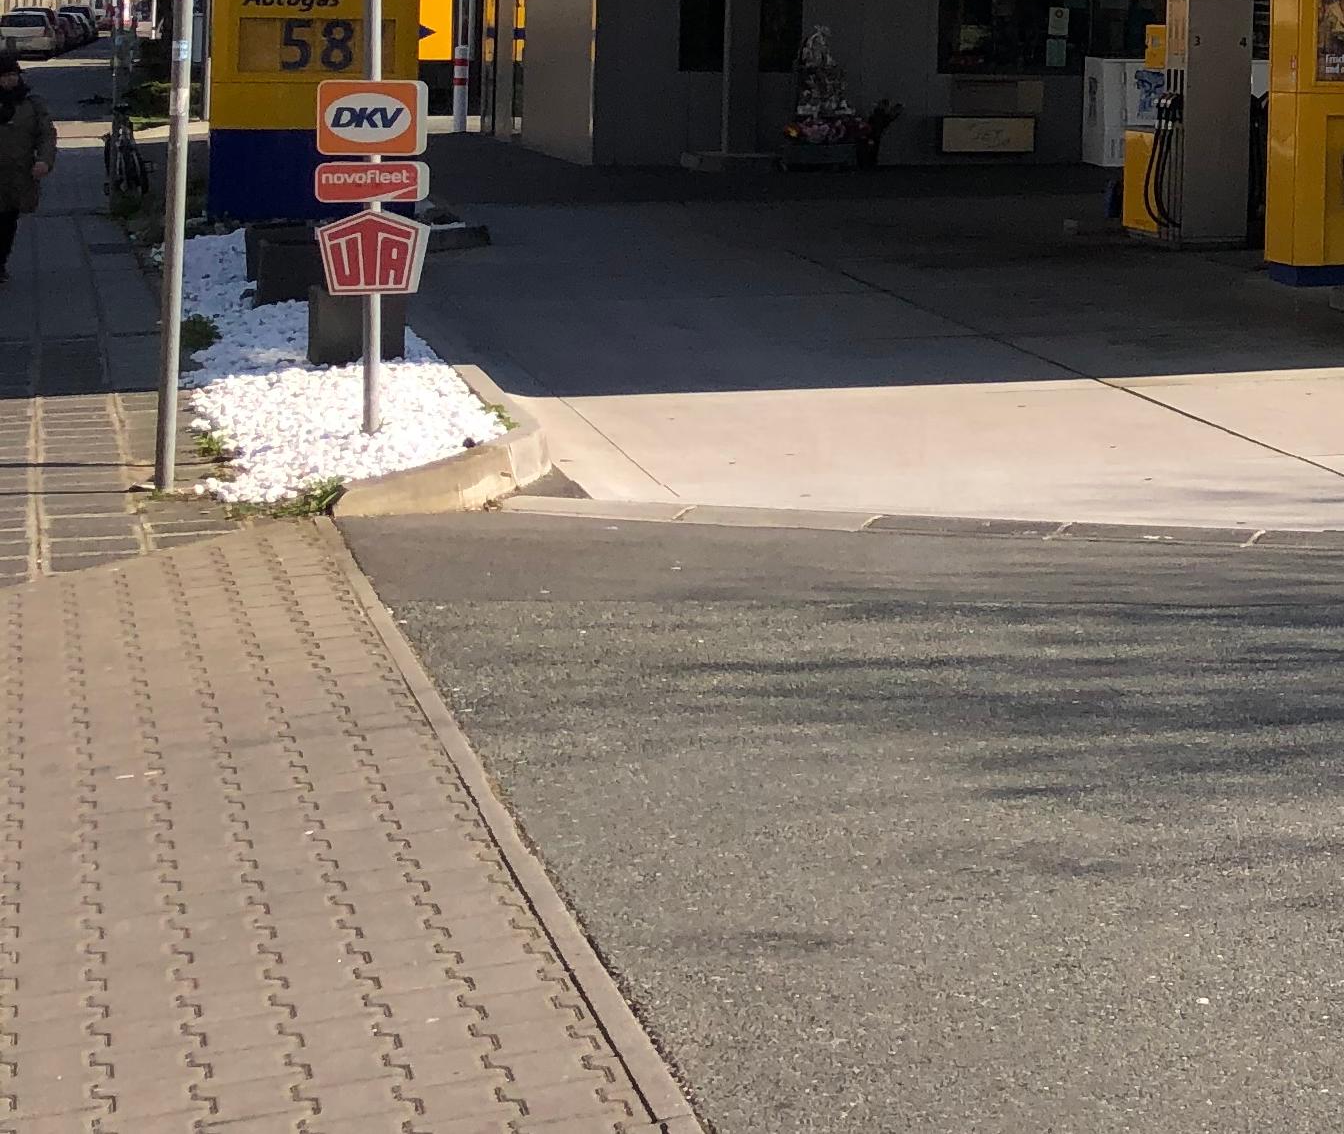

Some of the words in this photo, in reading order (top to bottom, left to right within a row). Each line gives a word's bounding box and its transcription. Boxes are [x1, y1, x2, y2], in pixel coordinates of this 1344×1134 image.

[281, 19, 353, 72] 58
[331, 106, 405, 128] DKV
[321, 169, 410, 184] novofleet
[327, 218, 412, 286] UTA
